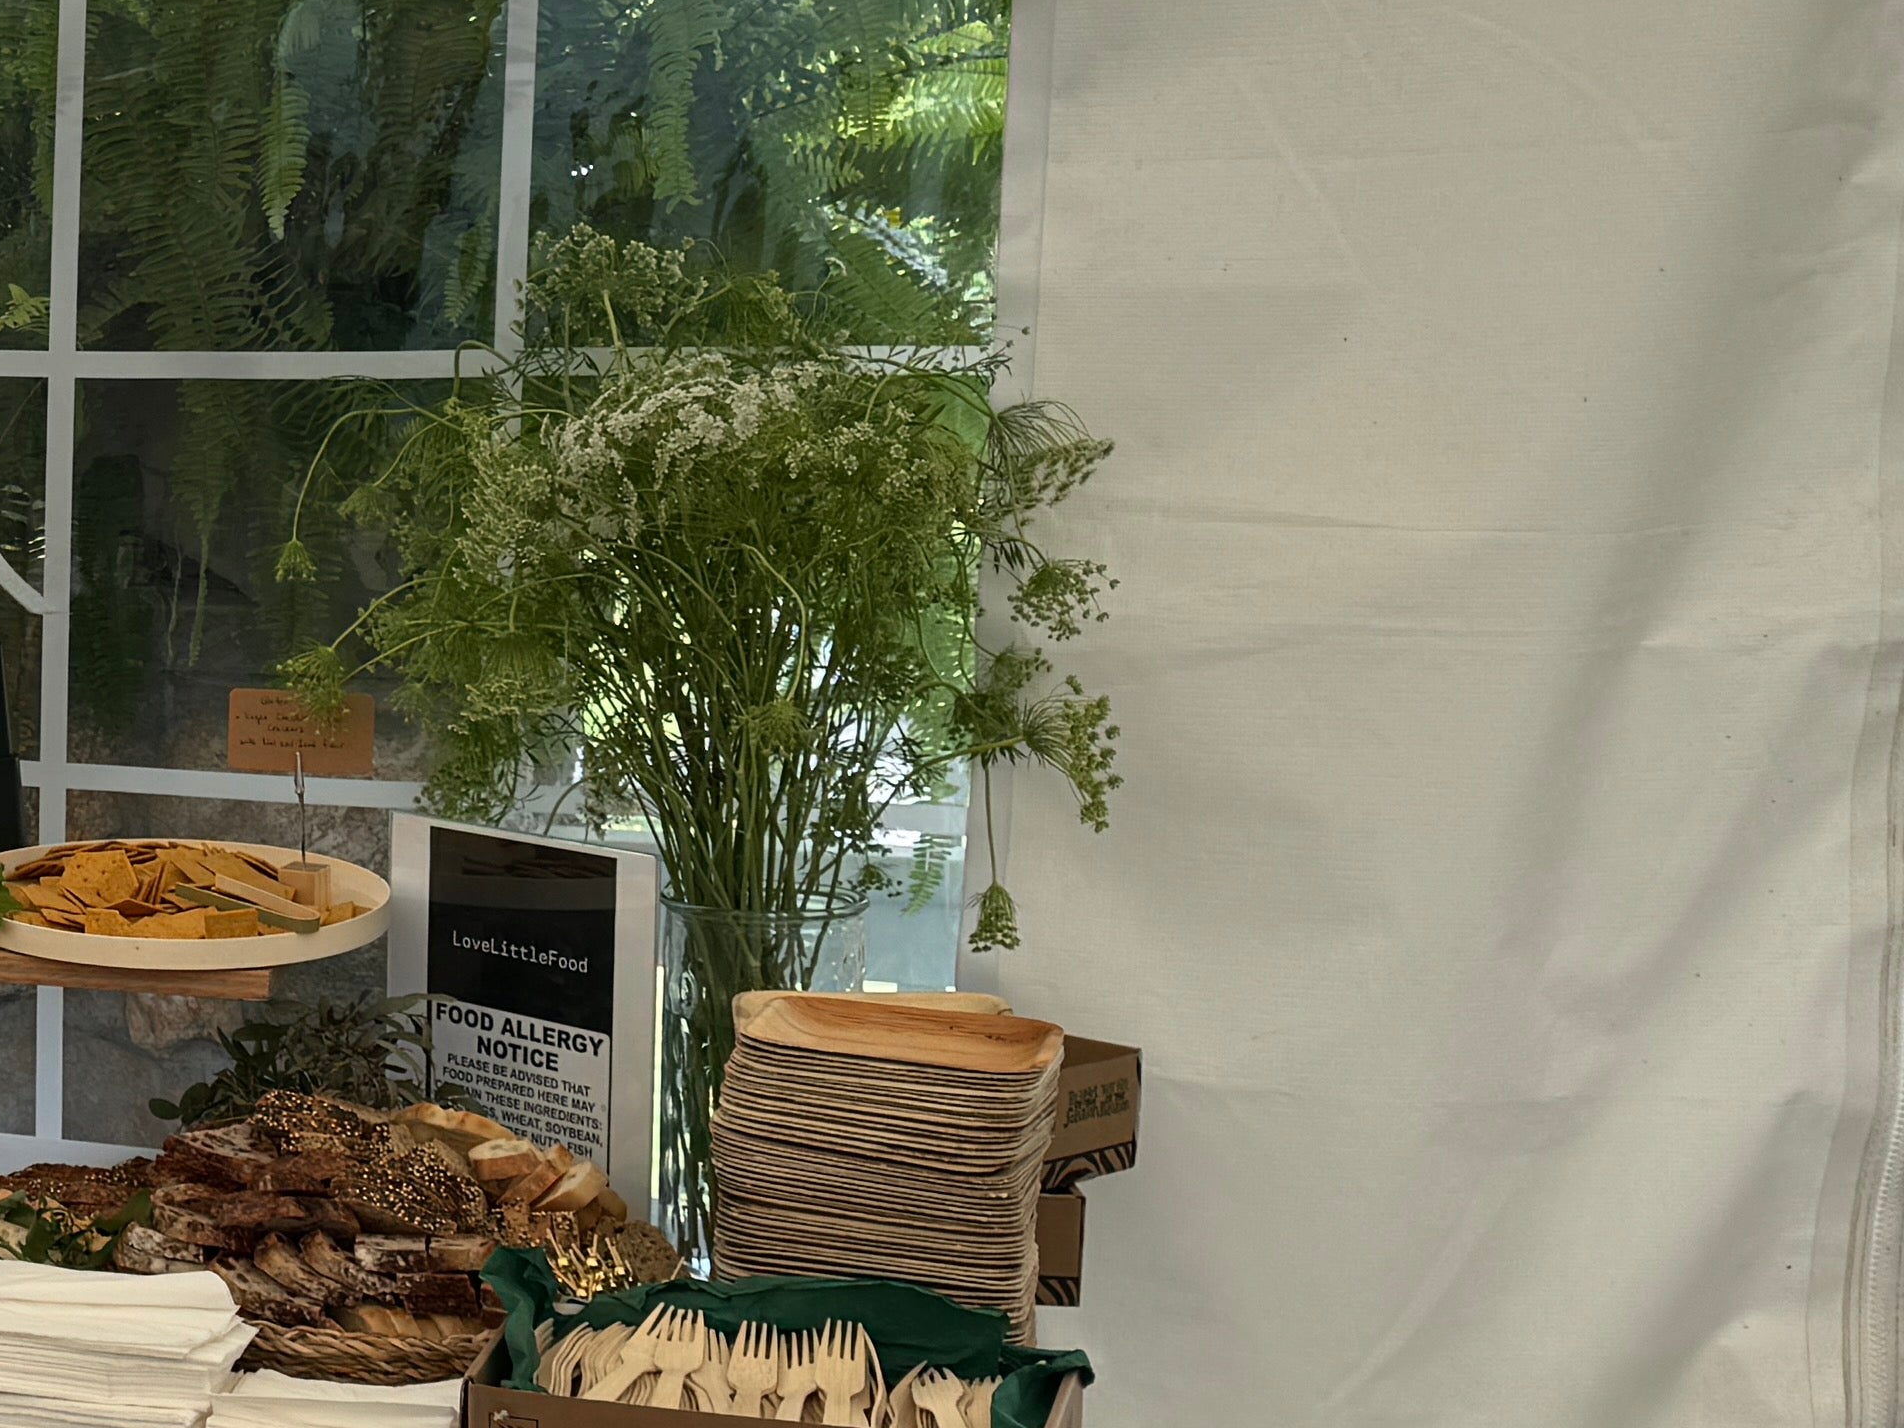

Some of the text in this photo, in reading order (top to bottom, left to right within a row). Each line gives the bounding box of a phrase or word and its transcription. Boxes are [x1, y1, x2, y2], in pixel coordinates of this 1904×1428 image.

[453, 930, 588, 973] LoveLittleFood
[436, 1002, 604, 1057] FOOD ALLERGY
[477, 1035, 559, 1072] NOTICE
[442, 1066, 596, 1113] FOOD PREPARED HERE MAY
[447, 1053, 591, 1098] PLEASE BE ADVISED THAT
[486, 1092, 521, 1110] THESE
[523, 1101, 604, 1131] INGREDIENTS:
[502, 1111, 543, 1131] WHEAT,
[545, 1121, 604, 1148] SOYBEAN,
[568, 1143, 593, 1159] FISH
